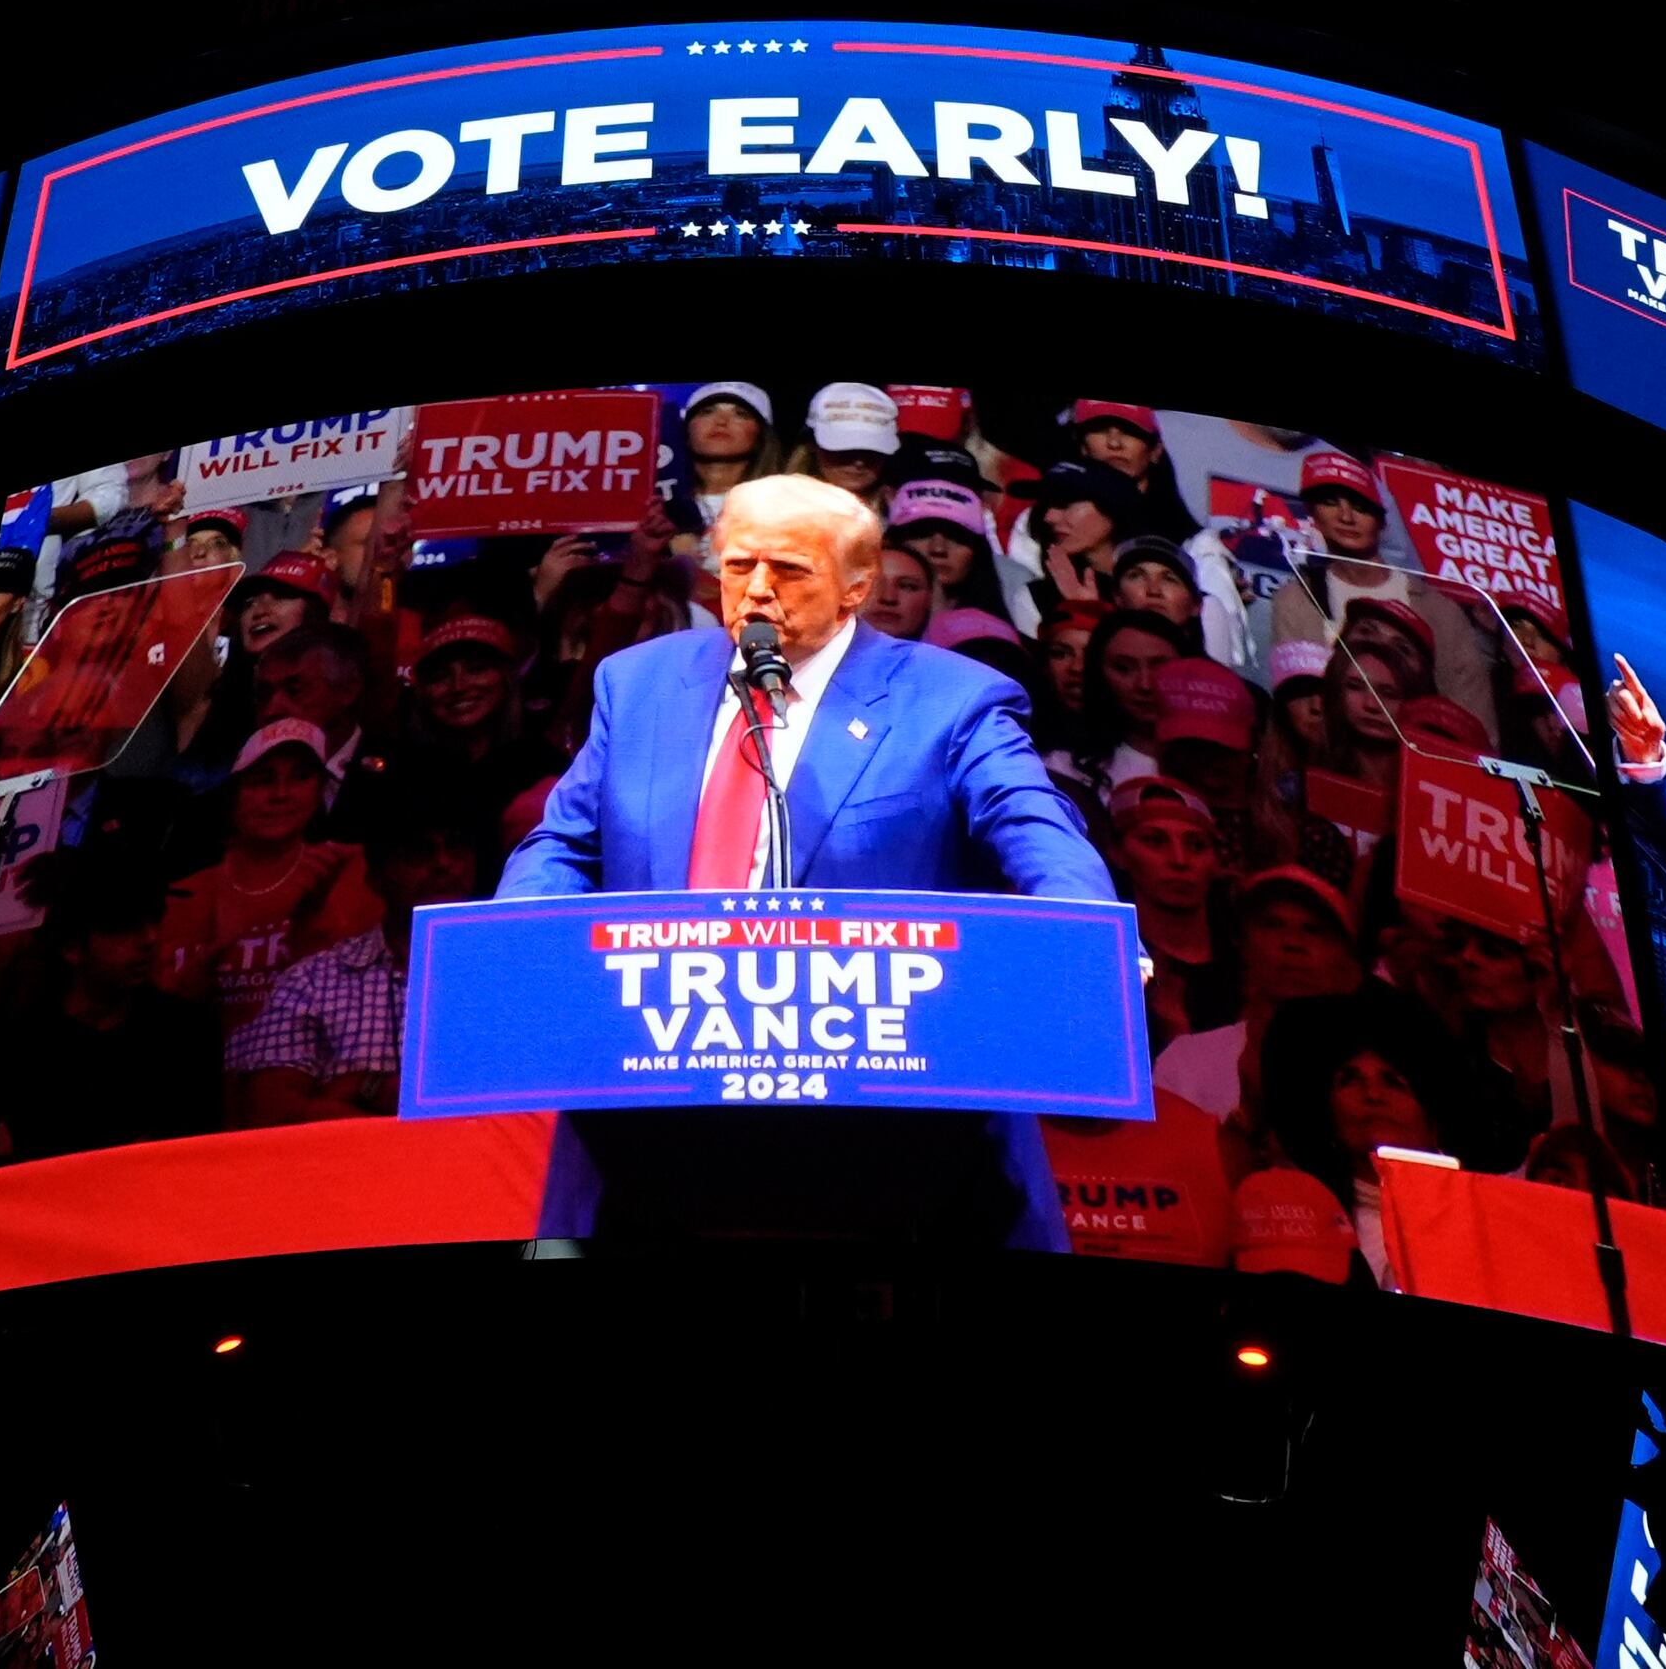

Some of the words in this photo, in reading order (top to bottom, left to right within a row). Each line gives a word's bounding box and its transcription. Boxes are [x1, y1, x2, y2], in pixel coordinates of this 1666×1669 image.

[242, 102, 656, 235] VOTE
[708, 97, 1270, 220] EARLY!
[198, 450, 280, 479] WILL
[290, 437, 344, 463] FIX
[355, 430, 387, 453] IT
[421, 430, 645, 474] TRUMP
[417, 472, 514, 500] WILL
[525, 468, 592, 494] FIX
[602, 468, 641, 492] IT
[1434, 482, 1534, 528] MAKE
[1410, 502, 1557, 558] AMERICA
[1435, 532, 1551, 581] GREAT
[1438, 558, 1562, 611] AGAIN!
[1419, 826, 1531, 893] WILL
[605, 920, 732, 949] TRUMP
[740, 920, 831, 946] WILL
[840, 921, 899, 947] FIX
[907, 922, 941, 948] IT
[605, 950, 944, 1007] TRUMP
[641, 1006, 907, 1052] VANCE
[622, 1055, 680, 1072] MAKE
[685, 1054, 778, 1070] AMERICA
[782, 1054, 850, 1070] GREAT
[855, 1055, 927, 1072] AGAIN!
[721, 1072, 829, 1100] 2024
[1064, 1212, 1147, 1232] ANCE
